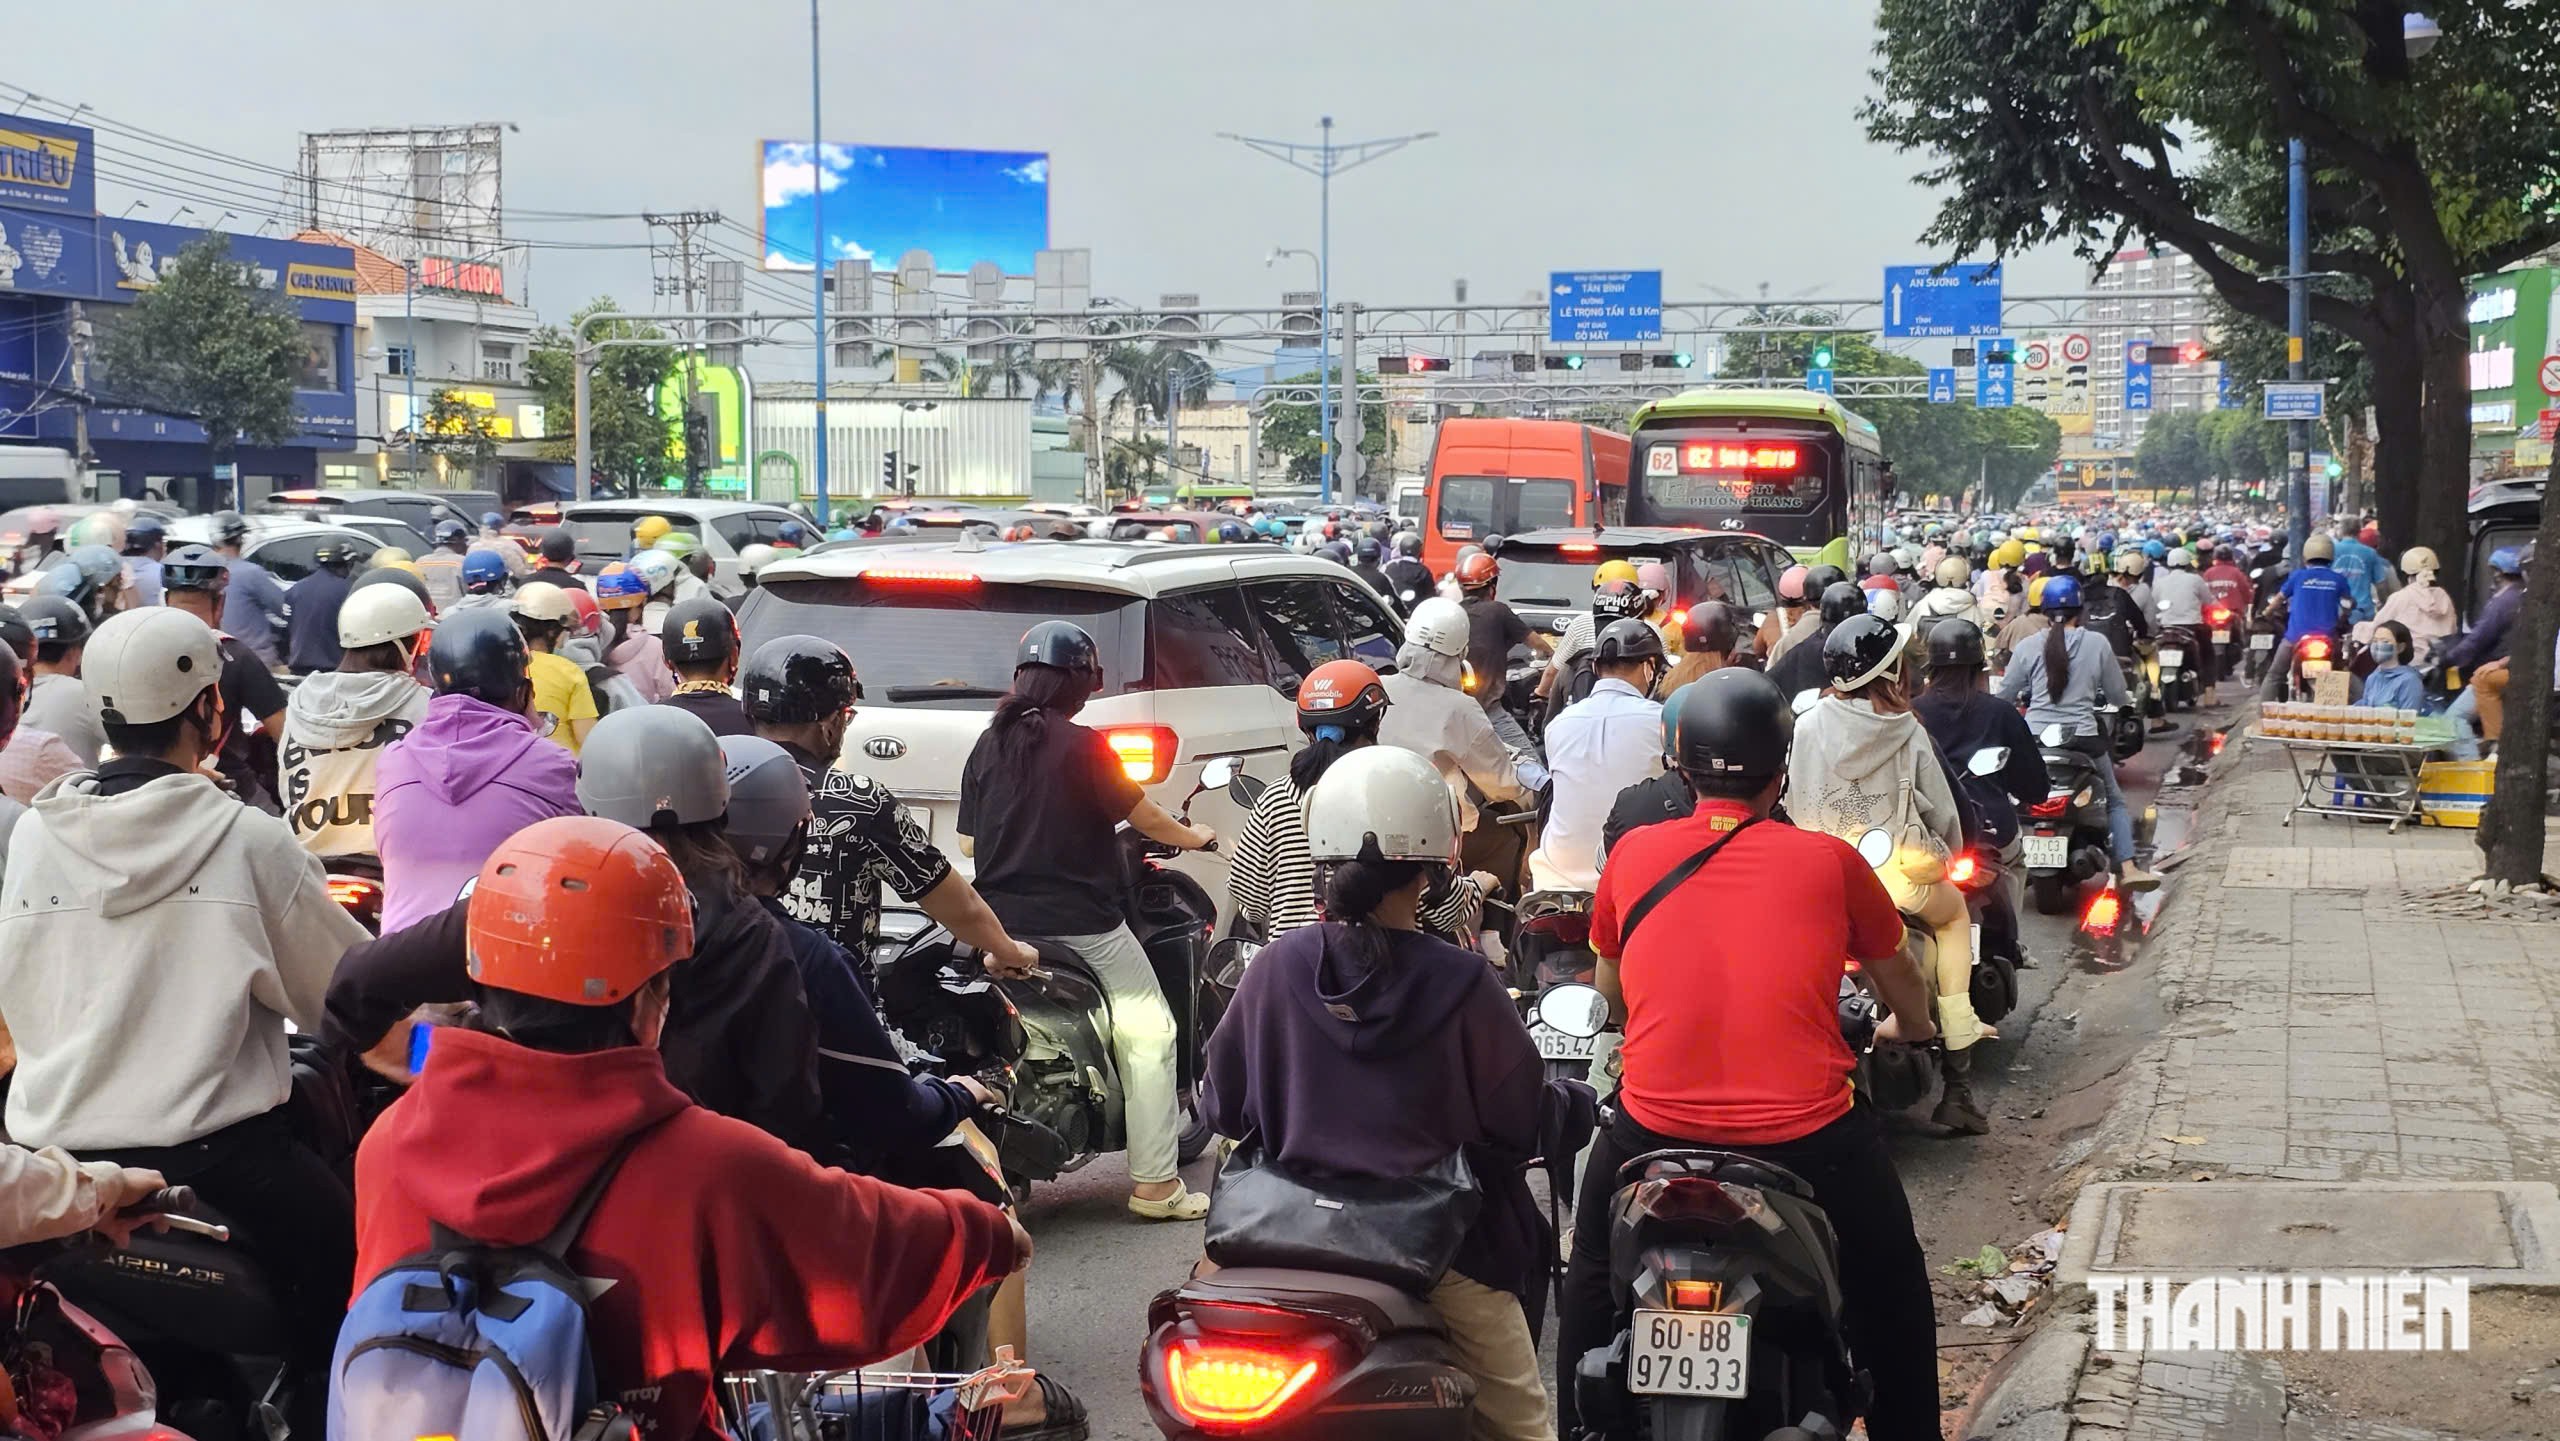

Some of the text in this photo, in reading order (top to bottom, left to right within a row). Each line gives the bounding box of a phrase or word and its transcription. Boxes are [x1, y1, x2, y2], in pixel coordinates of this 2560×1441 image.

[291, 271, 313, 289] CAR
[1909, 277, 1923, 288] AN
[1582, 282, 1625, 293] TÂN BÌNH
[1560, 306, 1572, 317] LÊ
[1574, 307, 1603, 318] TRỌNG
[1606, 304, 1625, 316] TẤN
[1644, 307, 1660, 316] Km
[1575, 330, 1588, 341] GÒ
[1636, 331, 1643, 340] 4
[1644, 331, 1660, 340] Km
[1909, 324, 1999, 336] TÂY NINH 34 Km
[2070, 343, 2083, 355] 60
[1652, 452, 1673, 471] 62
[1755, 483, 1777, 495] TY
[1750, 496, 1803, 508] TRANG
[869, 741, 899, 756] KIA
[1650, 1317, 1731, 1352] 60-B8
[1637, 1354, 1741, 1391] 979.33
